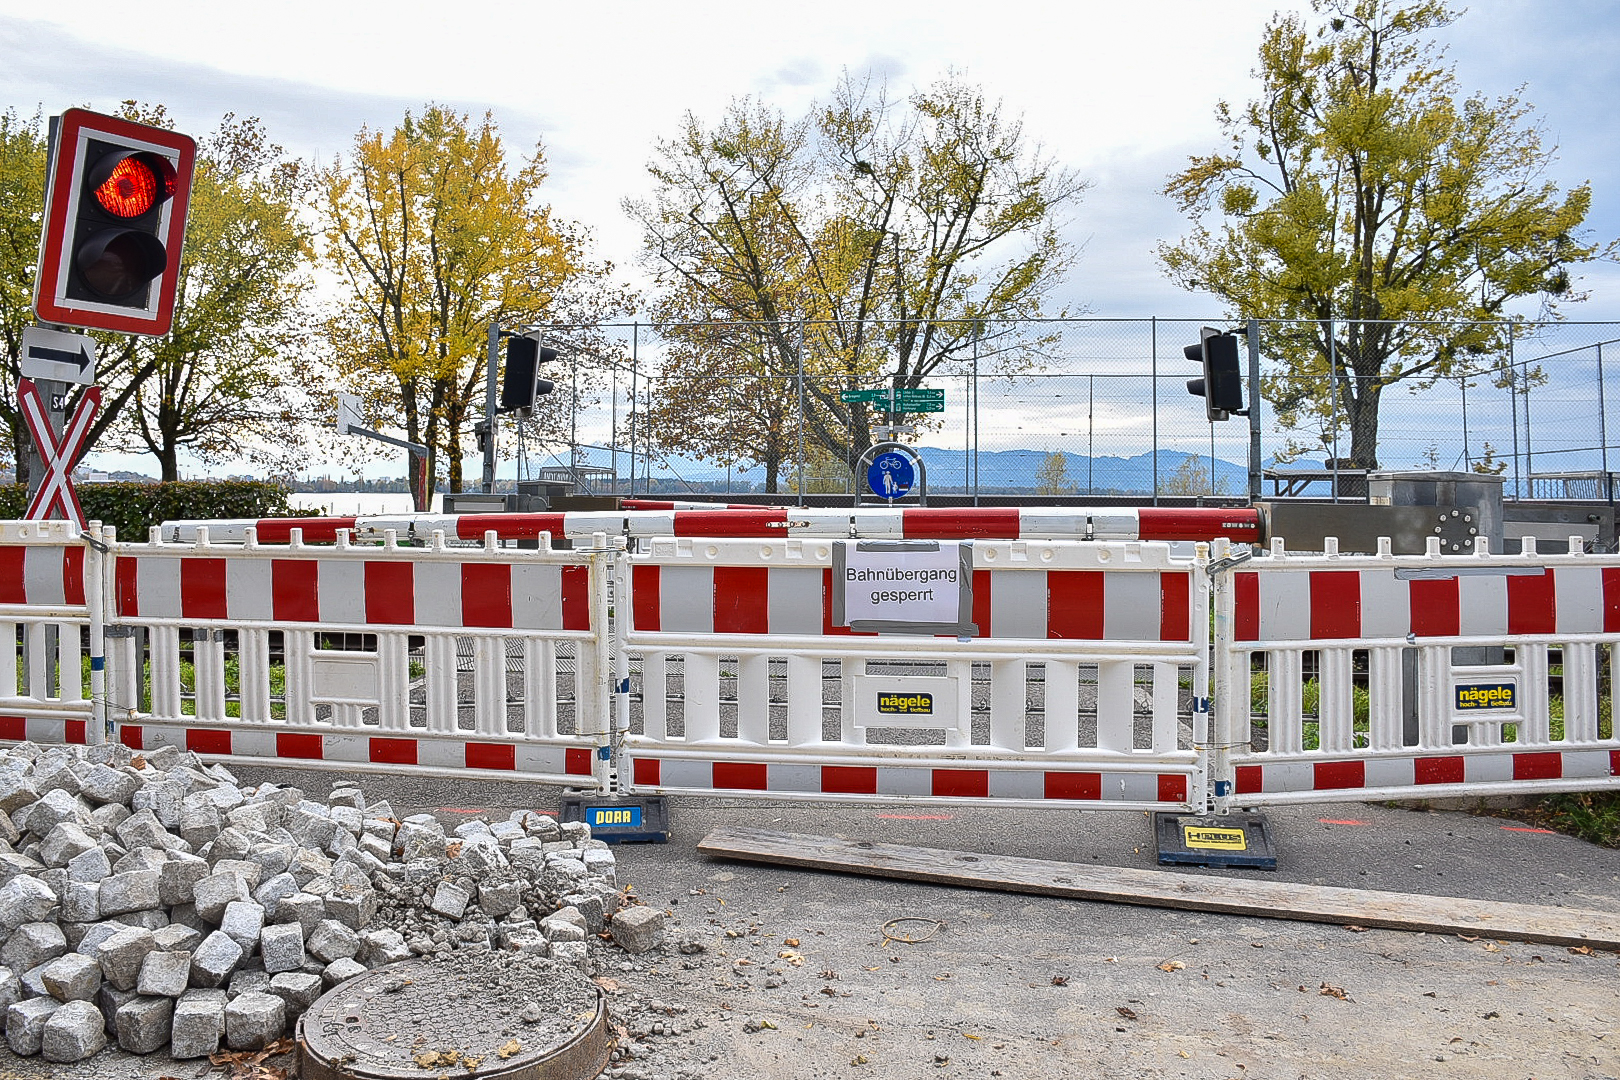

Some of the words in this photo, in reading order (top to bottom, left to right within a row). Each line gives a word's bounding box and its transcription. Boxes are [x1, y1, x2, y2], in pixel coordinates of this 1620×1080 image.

[846, 567, 957, 584] Bahnübergang
[870, 588, 934, 605] gesperrt
[880, 694, 931, 709] nägele
[1459, 686, 1512, 703] nägele
